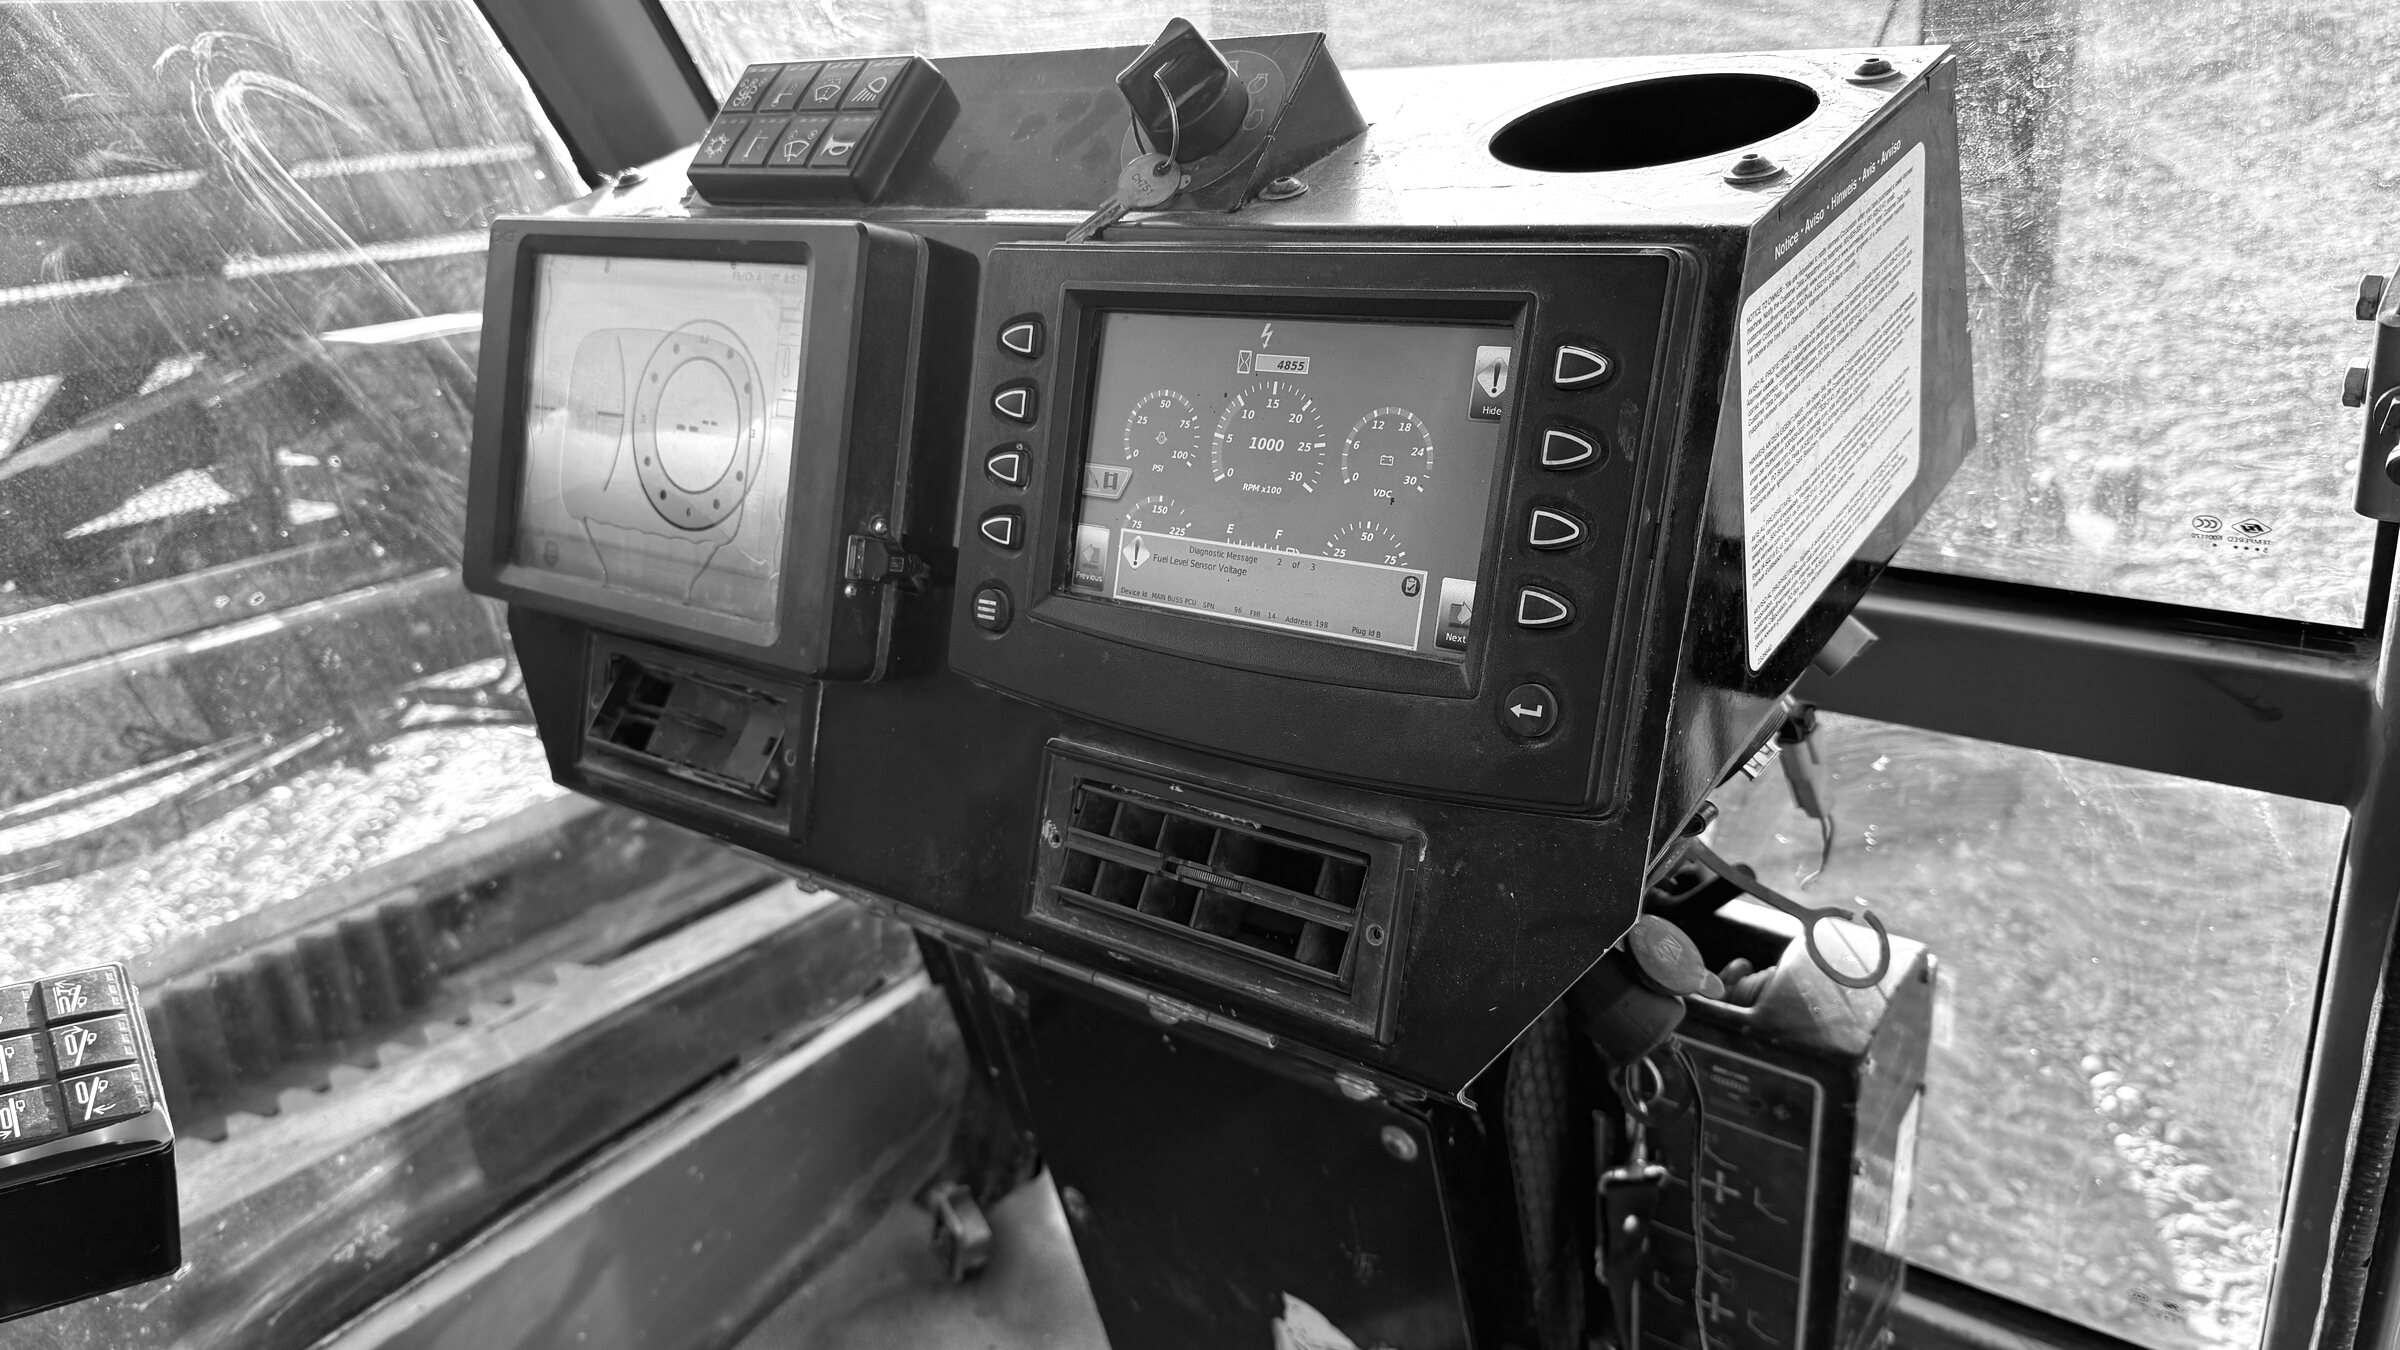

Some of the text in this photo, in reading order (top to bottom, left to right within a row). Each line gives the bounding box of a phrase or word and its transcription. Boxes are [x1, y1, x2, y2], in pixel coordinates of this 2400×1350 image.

[1132, 174, 1154, 195] CH751
[1775, 140, 1901, 260] Notice Aviso Hinweis Avis Avviso
[1277, 360, 1305, 371] 4855
[1160, 400, 1171, 408] 50
[1266, 400, 1280, 408] 15
[1242, 410, 1255, 420] 10
[1482, 406, 1501, 415] Hide
[1137, 416, 1148, 424] 25
[1289, 414, 1303, 423] 20
[1180, 420, 1191, 429] 75
[1372, 421, 1384, 430] 12
[1398, 423, 1411, 432] 18
[1226, 434, 1233, 443] 5
[1249, 437, 1284, 452] 1000
[1297, 442, 1311, 452] 25
[1353, 441, 1360, 449] 6
[1172, 451, 1188, 459] 100
[1411, 448, 1425, 456] 24
[1227, 468, 1234, 477] 0
[1288, 472, 1302, 481] 30
[1352, 473, 1359, 481] 0
[1404, 476, 1417, 485] 30
[1242, 483, 1282, 494] RPM x100
[1373, 489, 1392, 498] VDC
[1152, 505, 1168, 514] 150
[1169, 527, 1186, 536] 225
[1227, 523, 1234, 534] E
[1275, 529, 1283, 539] F
[1361, 532, 1374, 542] 50
[1333, 548, 1346, 557] 25
[1189, 546, 1315, 571] Diagnostic Message 2 of 3
[1384, 555, 1397, 565] 75
[1153, 554, 1248, 576] Fuel Level Sensor Voltage
[1076, 572, 1102, 583] Previous
[1121, 587, 1140, 597] Device
[1152, 592, 1165, 601] MAIN
[1167, 595, 1183, 604] BUSS
[1185, 598, 1197, 606] PCU
[1203, 602, 1215, 610] SPN
[1268, 611, 1276, 619] 14
[1285, 615, 1312, 627] Address
[1315, 620, 1329, 629] 198
[1352, 626, 1367, 637] Plug
[1445, 632, 1466, 644] Next
[1656, 930, 1682, 963] 12V
